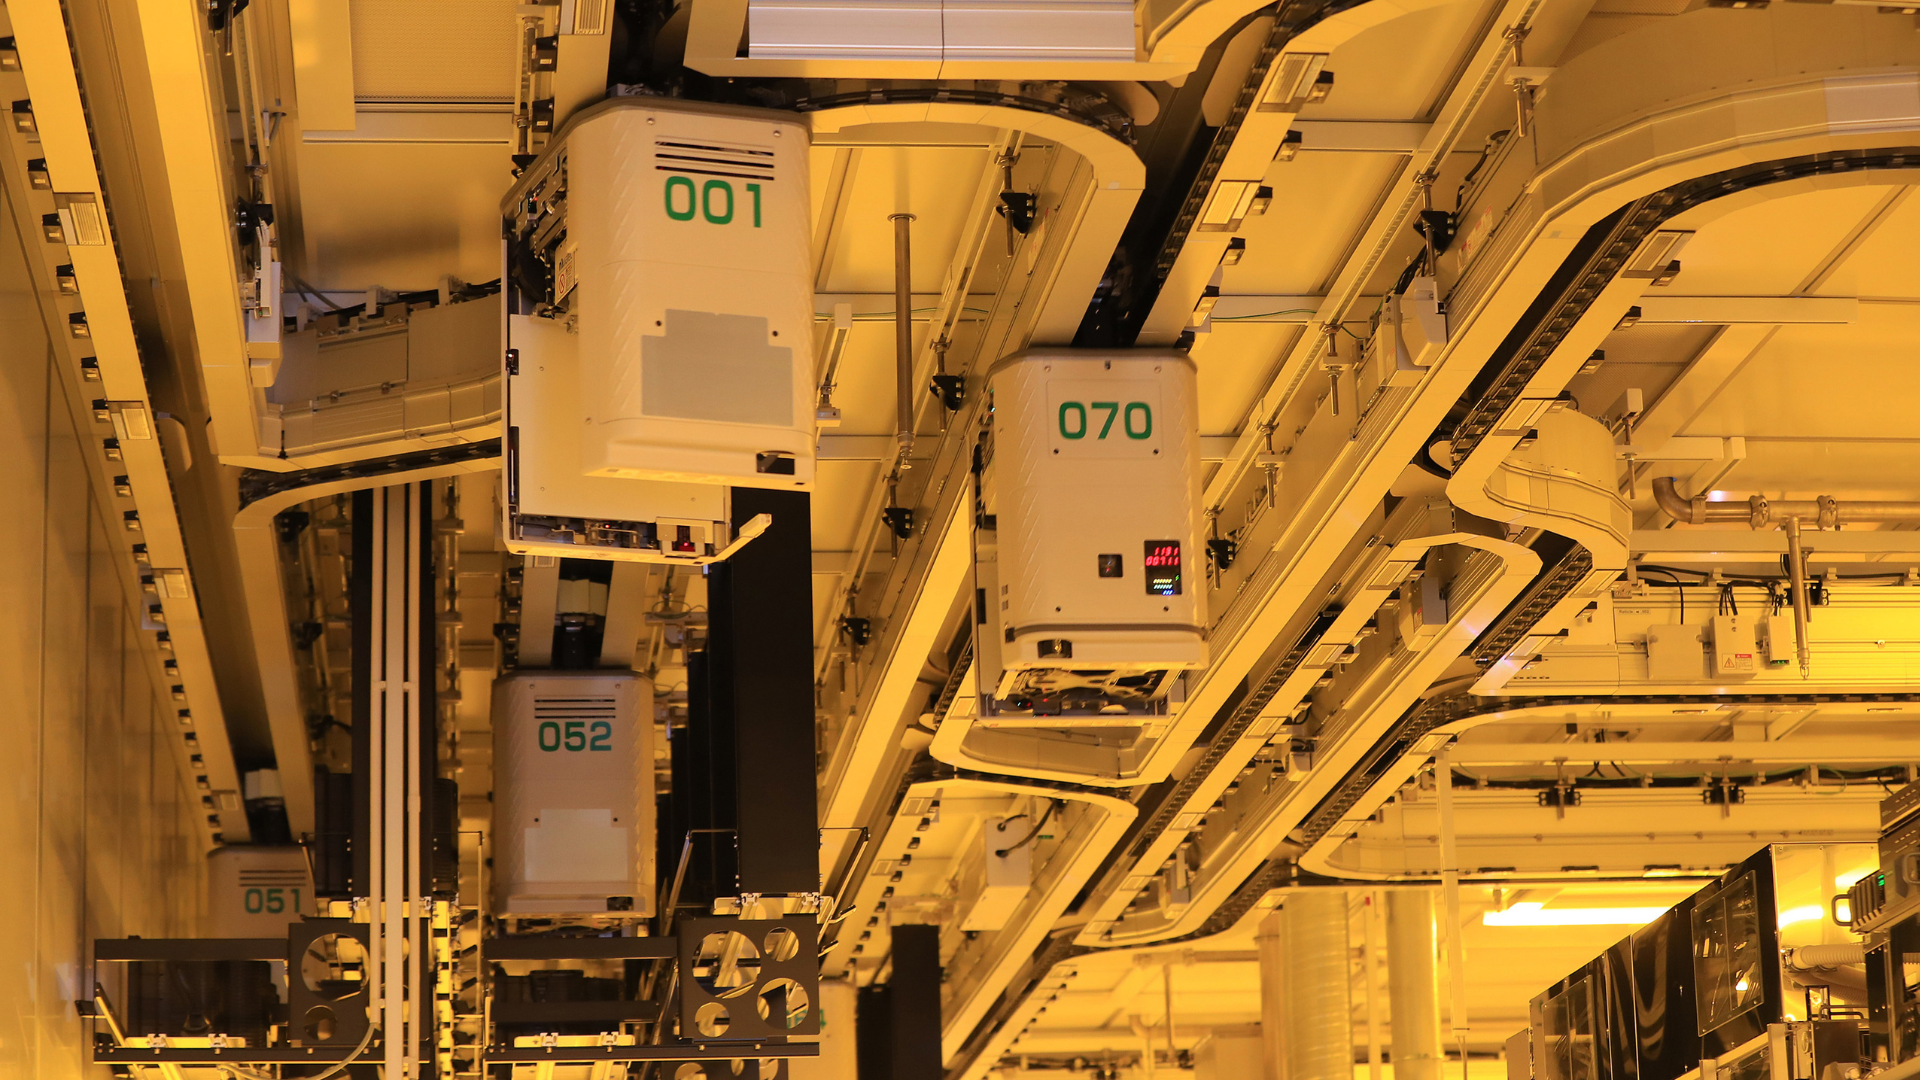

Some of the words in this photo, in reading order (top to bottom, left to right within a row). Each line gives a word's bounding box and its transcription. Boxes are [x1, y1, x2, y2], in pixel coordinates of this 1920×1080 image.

[664, 175, 762, 228] 001
[1058, 401, 1153, 440] 070
[538, 721, 612, 752] 052
[245, 888, 300, 914] 051
